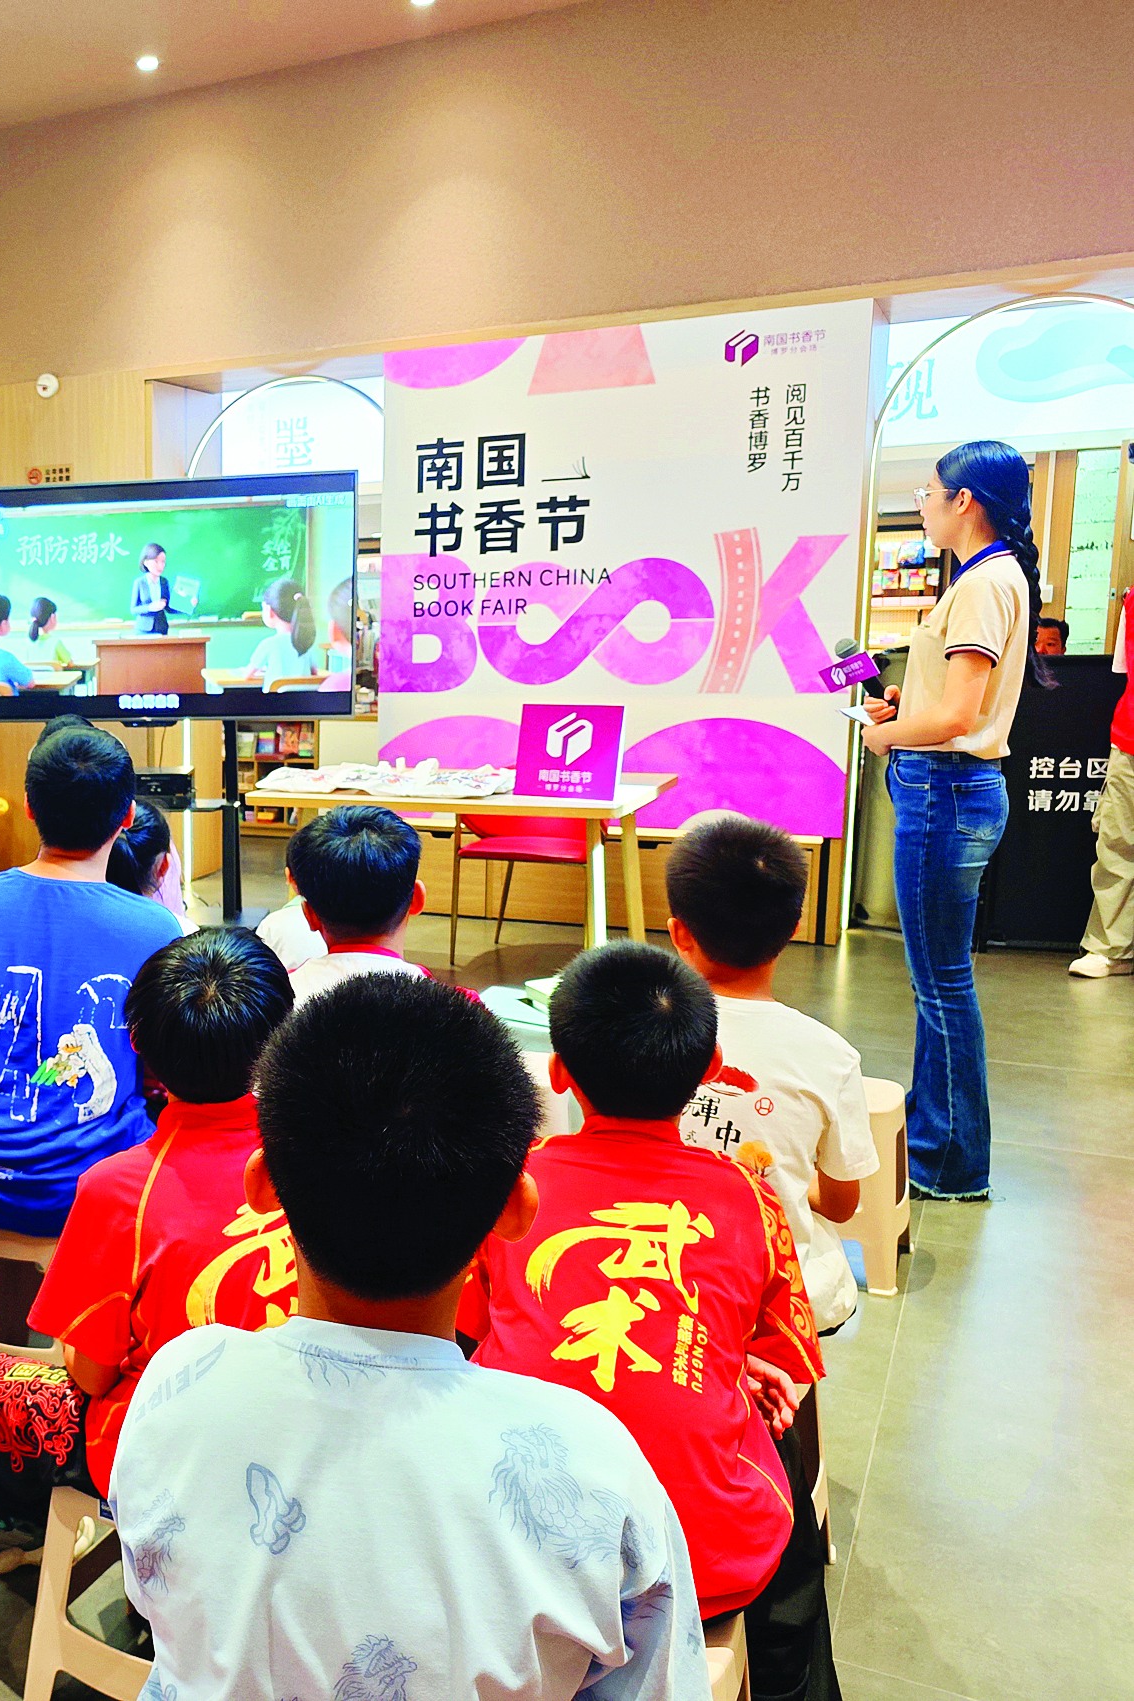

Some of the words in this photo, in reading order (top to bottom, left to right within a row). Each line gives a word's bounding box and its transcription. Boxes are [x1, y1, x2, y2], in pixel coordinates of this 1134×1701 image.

[763, 329, 826, 347] 南国书香节
[747, 386, 771, 474] 书香博罗
[781, 383, 807, 492] 阅见百千万
[416, 432, 526, 493] 南国
[414, 494, 590, 557] 书香节
[16, 533, 130, 567] 预防溺水
[413, 570, 532, 591] SOUTHERN
[540, 567, 612, 586] CHINA
[413, 600, 473, 618] BOOK
[481, 598, 527, 615] FAIR
[1029, 757, 1109, 779] 控台区
[525, 1200, 715, 1392] 武术
